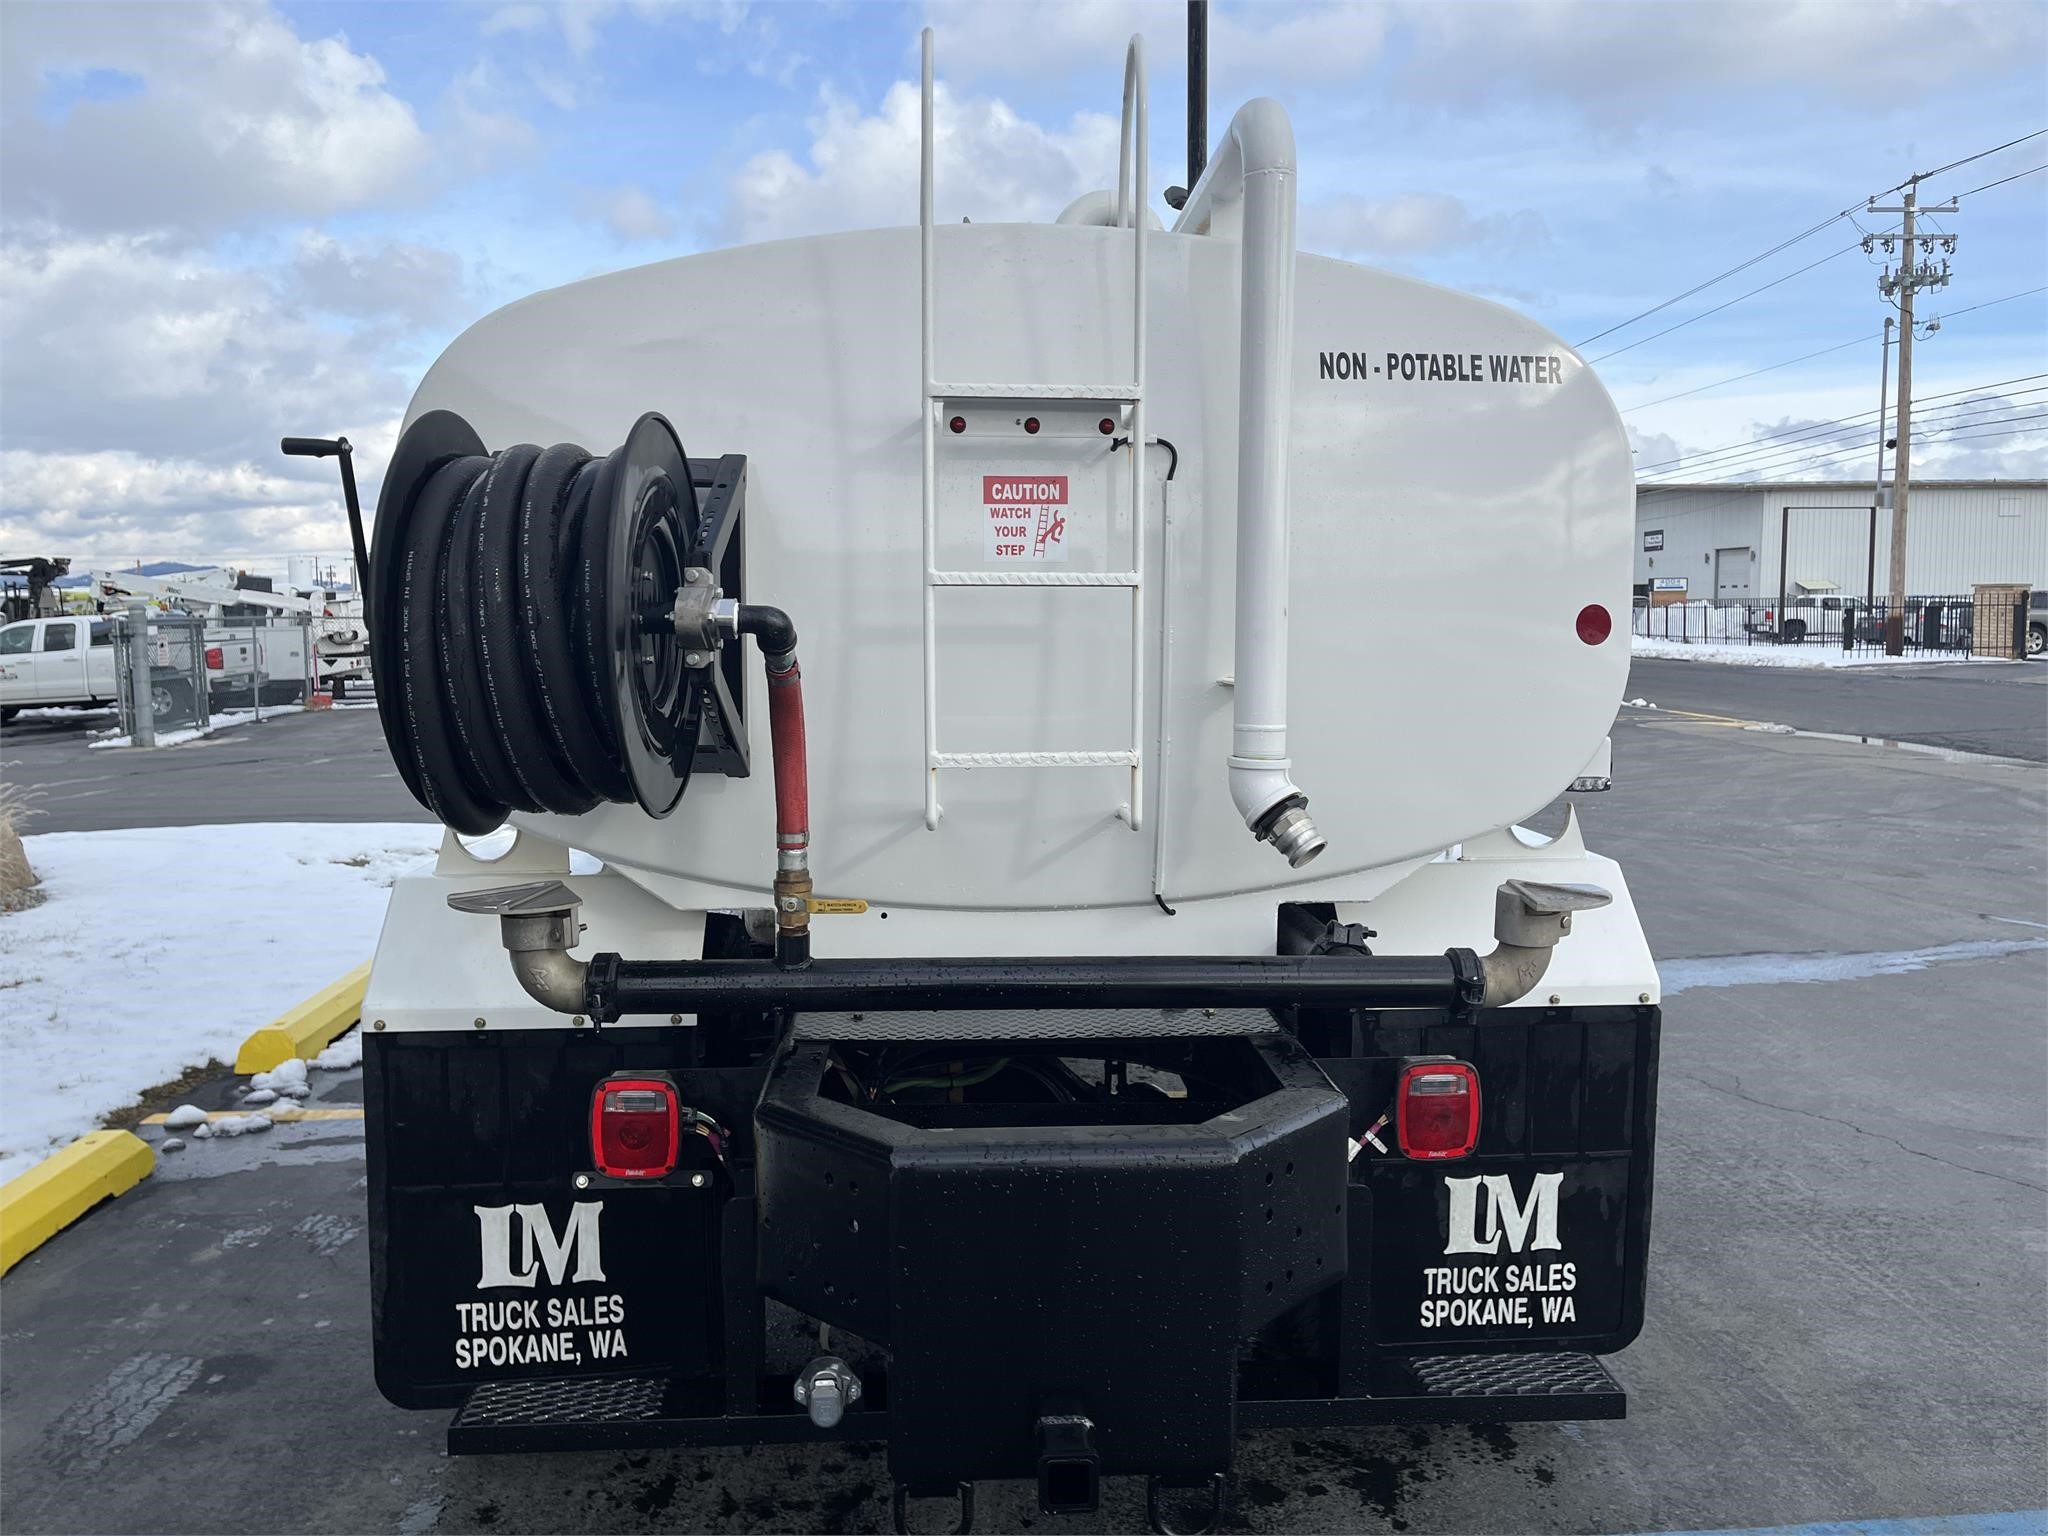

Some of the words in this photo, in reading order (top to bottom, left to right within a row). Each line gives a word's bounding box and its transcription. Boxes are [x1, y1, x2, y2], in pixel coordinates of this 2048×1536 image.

[1319, 351, 1367, 380] NON
[1386, 352, 1484, 382] POTABLE
[1488, 354, 1563, 385] WATER
[992, 483, 1060, 500] CAUTION
[990, 507, 1032, 519] WATCH
[994, 526, 1027, 537] YOUR
[405, 550, 415, 582] SPAIN
[996, 544, 1026, 556] STEP
[403, 586, 410, 600] IN
[530, 629, 539, 650] 200
[1443, 1172, 1564, 1255] LM
[474, 1201, 607, 1290] LM
[1424, 1266, 1500, 1295] TRUCK
[1505, 1263, 1577, 1293] SALES
[456, 1299, 541, 1333] TRUCK
[547, 1294, 625, 1329] SALES
[1420, 1297, 1534, 1329] SPOKANE,
[1541, 1296, 1576, 1324] WA
[455, 1332, 582, 1369] SPOKANE,
[588, 1329, 628, 1359] WA
